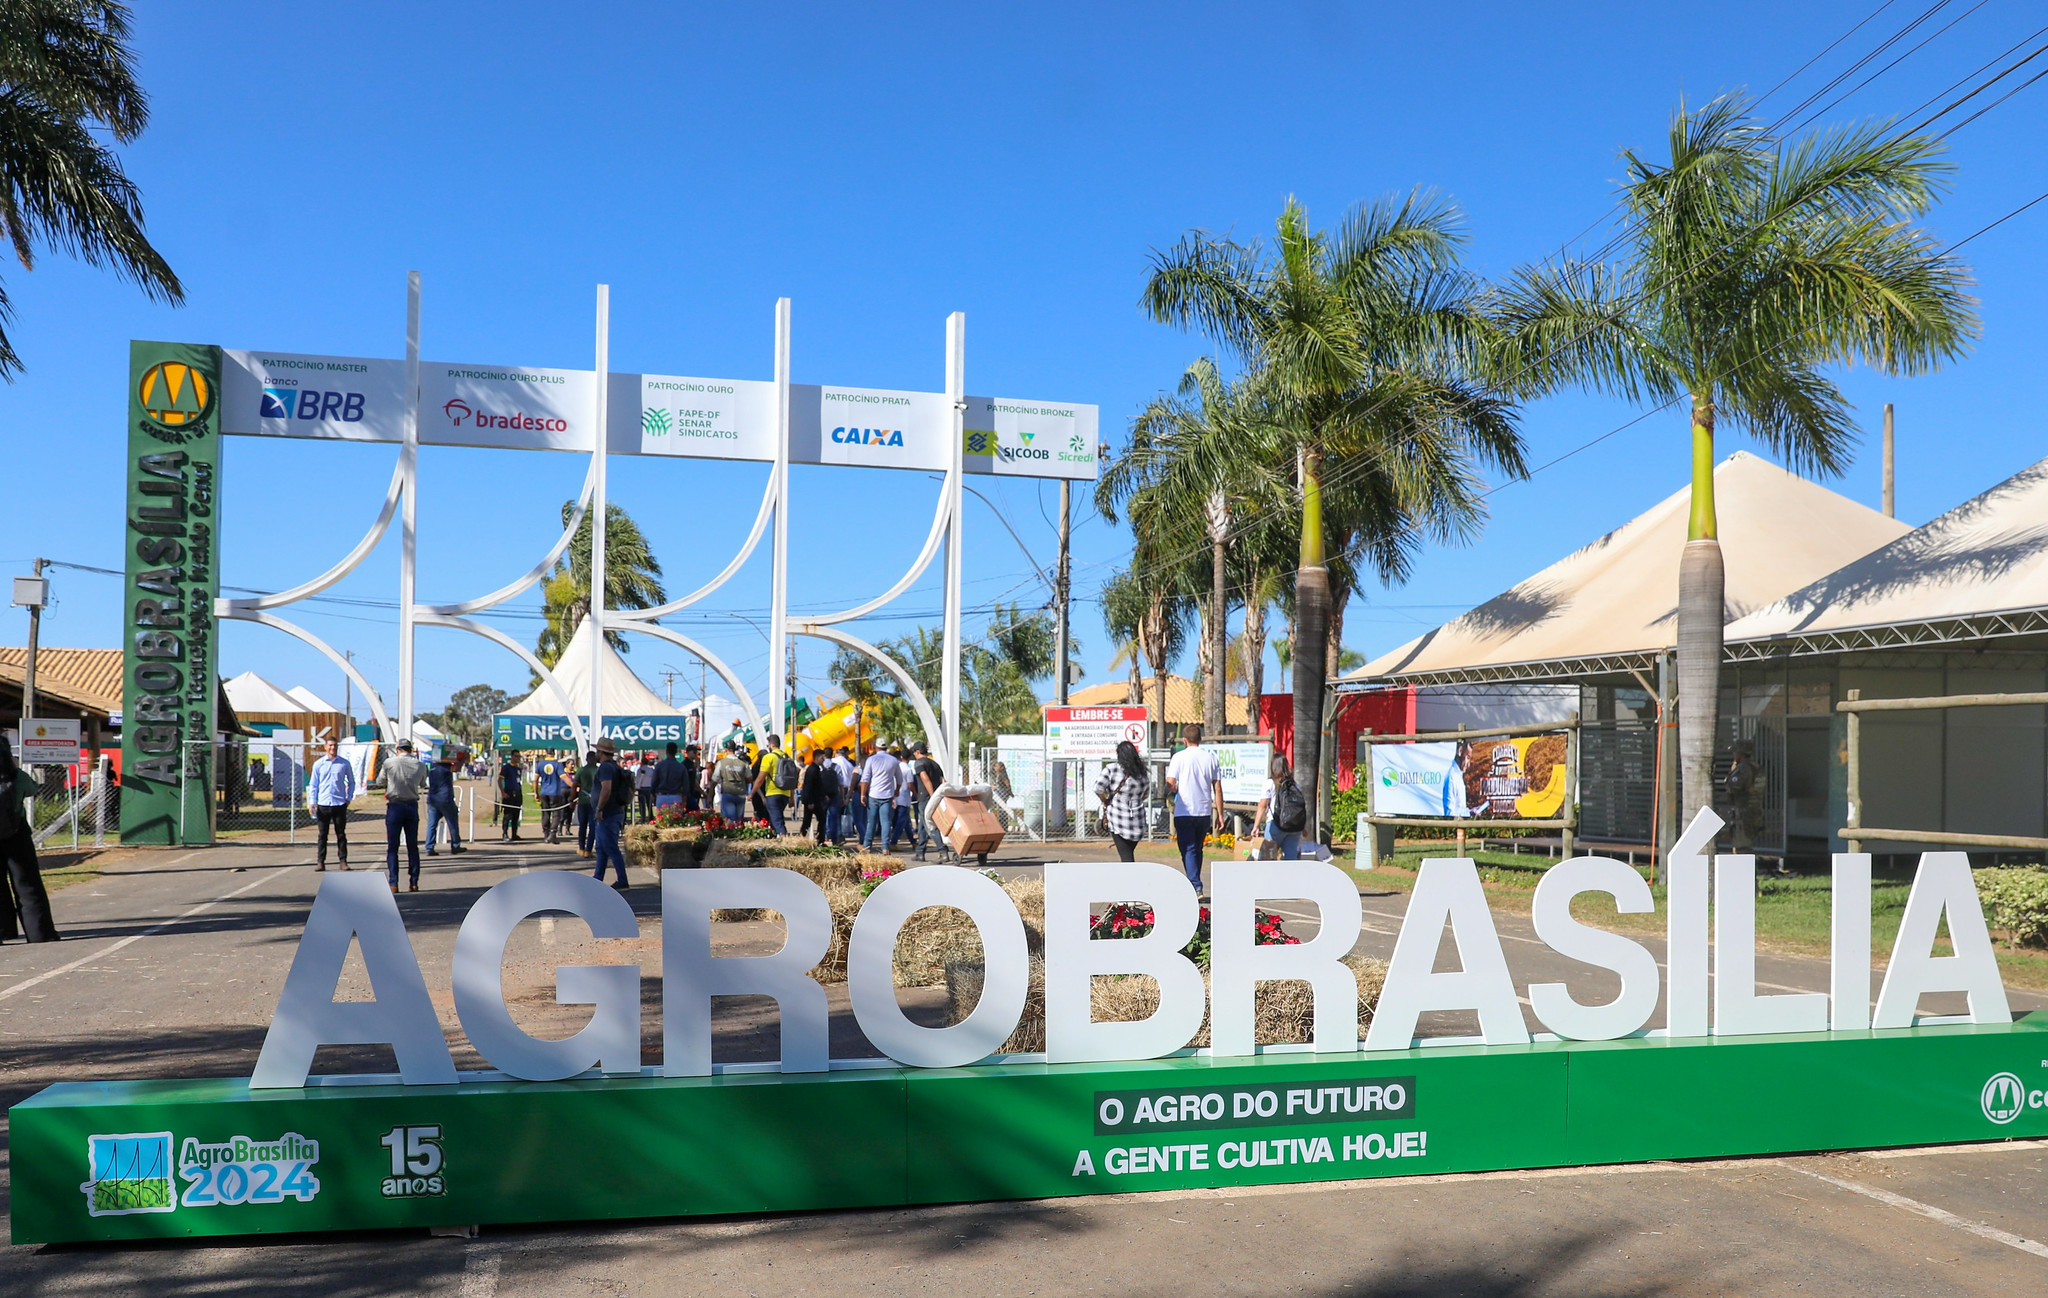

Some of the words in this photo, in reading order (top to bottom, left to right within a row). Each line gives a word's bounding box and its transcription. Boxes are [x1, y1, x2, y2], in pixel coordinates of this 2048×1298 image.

[262, 359, 324, 370] PATROCÍNIO
[326, 362, 368, 373] MASTER
[264, 376, 298, 386] banco
[448, 370, 507, 381] PATROCÍNIO
[510, 374, 539, 382] OURO
[541, 376, 565, 384] PLUS
[648, 381, 704, 392] PATROCÍNIO
[707, 386, 734, 394] OURO
[297, 390, 366, 422] BRB
[825, 393, 880, 403] PATROCÍNIO
[882, 397, 911, 406] PRATA
[679, 409, 720, 419] FAPE-DF
[987, 404, 1038, 414] PATROCÍNIO
[1041, 408, 1075, 417] BRONZE
[476, 409, 567, 432] bradesco
[679, 418, 712, 428] SENAR
[679, 428, 738, 439] SINDICATOS
[832, 427, 904, 447] CAIXA
[1004, 447, 1050, 460] SICOOB
[1058, 452, 1094, 462] Sicredi
[128, 450, 187, 785] AGROBRASÍLIA
[185, 587, 210, 706] Tecnológico
[1070, 709, 1123, 720] LEMBRE-SE
[184, 709, 208, 779] Parque
[1219, 749, 1237, 767] BOA
[1219, 768, 1237, 779] AFRA
[249, 805, 2012, 1090] AGROBRASÍLIA
[1099, 1098, 1124, 1126] O
[1133, 1093, 1225, 1124] AGRO
[1233, 1090, 1278, 1119] DO
[1286, 1083, 1406, 1115] FUTURO
[183, 1136, 315, 1168] AgroBrasília
[381, 1126, 443, 1175] 15
[1072, 1150, 1096, 1176] A
[1104, 1144, 1209, 1175] GENTE
[1217, 1136, 1334, 1169] CULTIVA
[1343, 1131, 1428, 1161] HOJE!
[185, 1163, 316, 1202] 2024
[381, 1176, 443, 1196] anos
